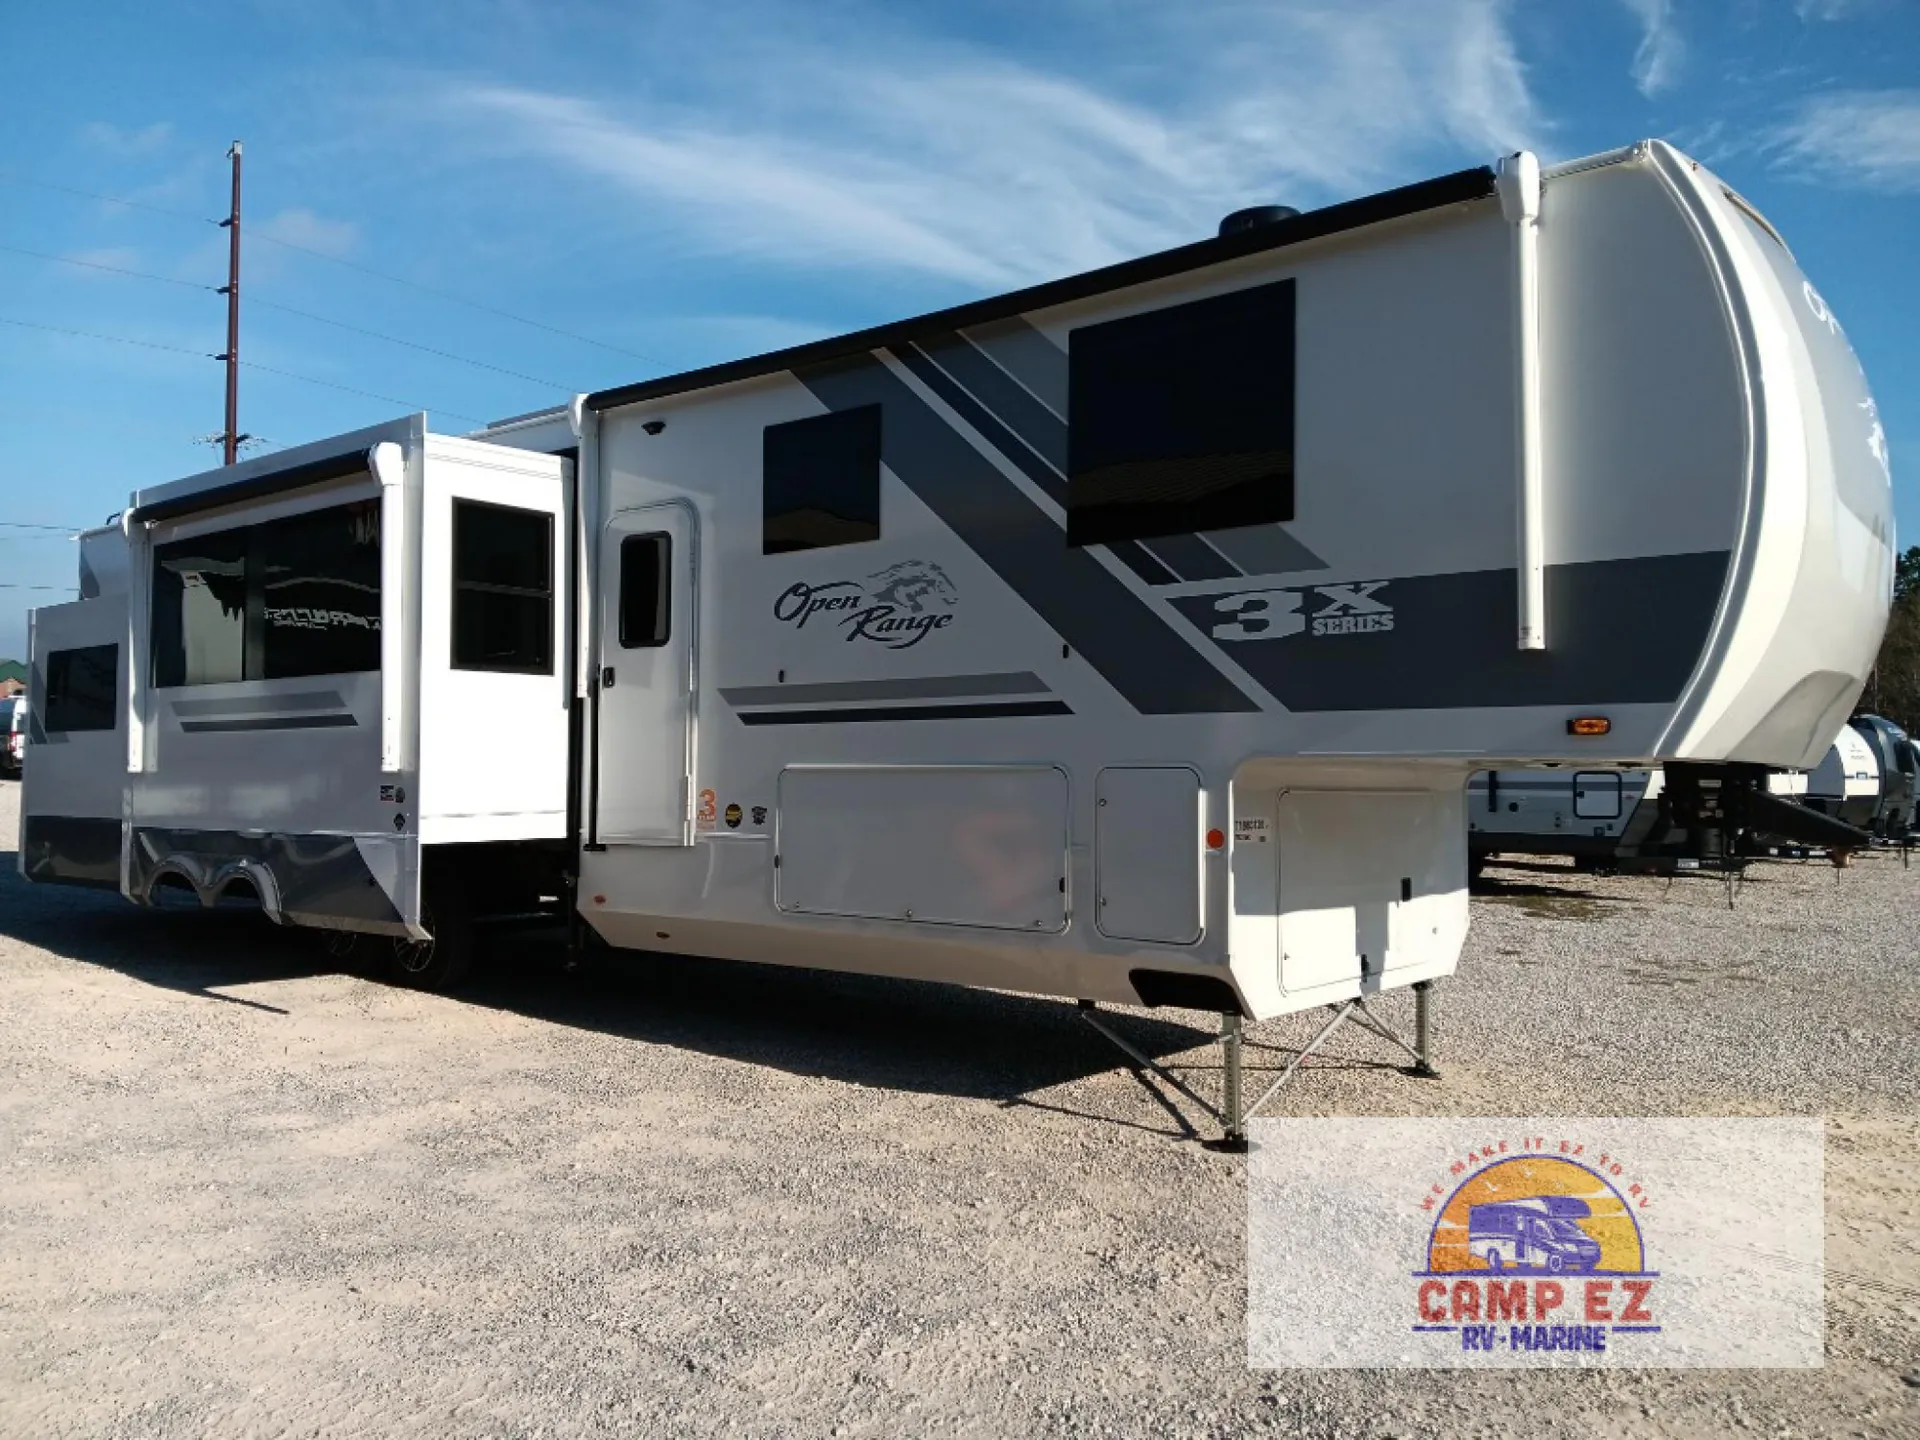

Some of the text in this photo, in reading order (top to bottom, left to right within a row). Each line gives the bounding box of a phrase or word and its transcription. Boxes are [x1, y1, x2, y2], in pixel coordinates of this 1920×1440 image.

[774, 580, 865, 629] Open
[837, 605, 954, 650] Range
[1312, 614, 1395, 637] SERIES
[698, 788, 716, 815] 3
